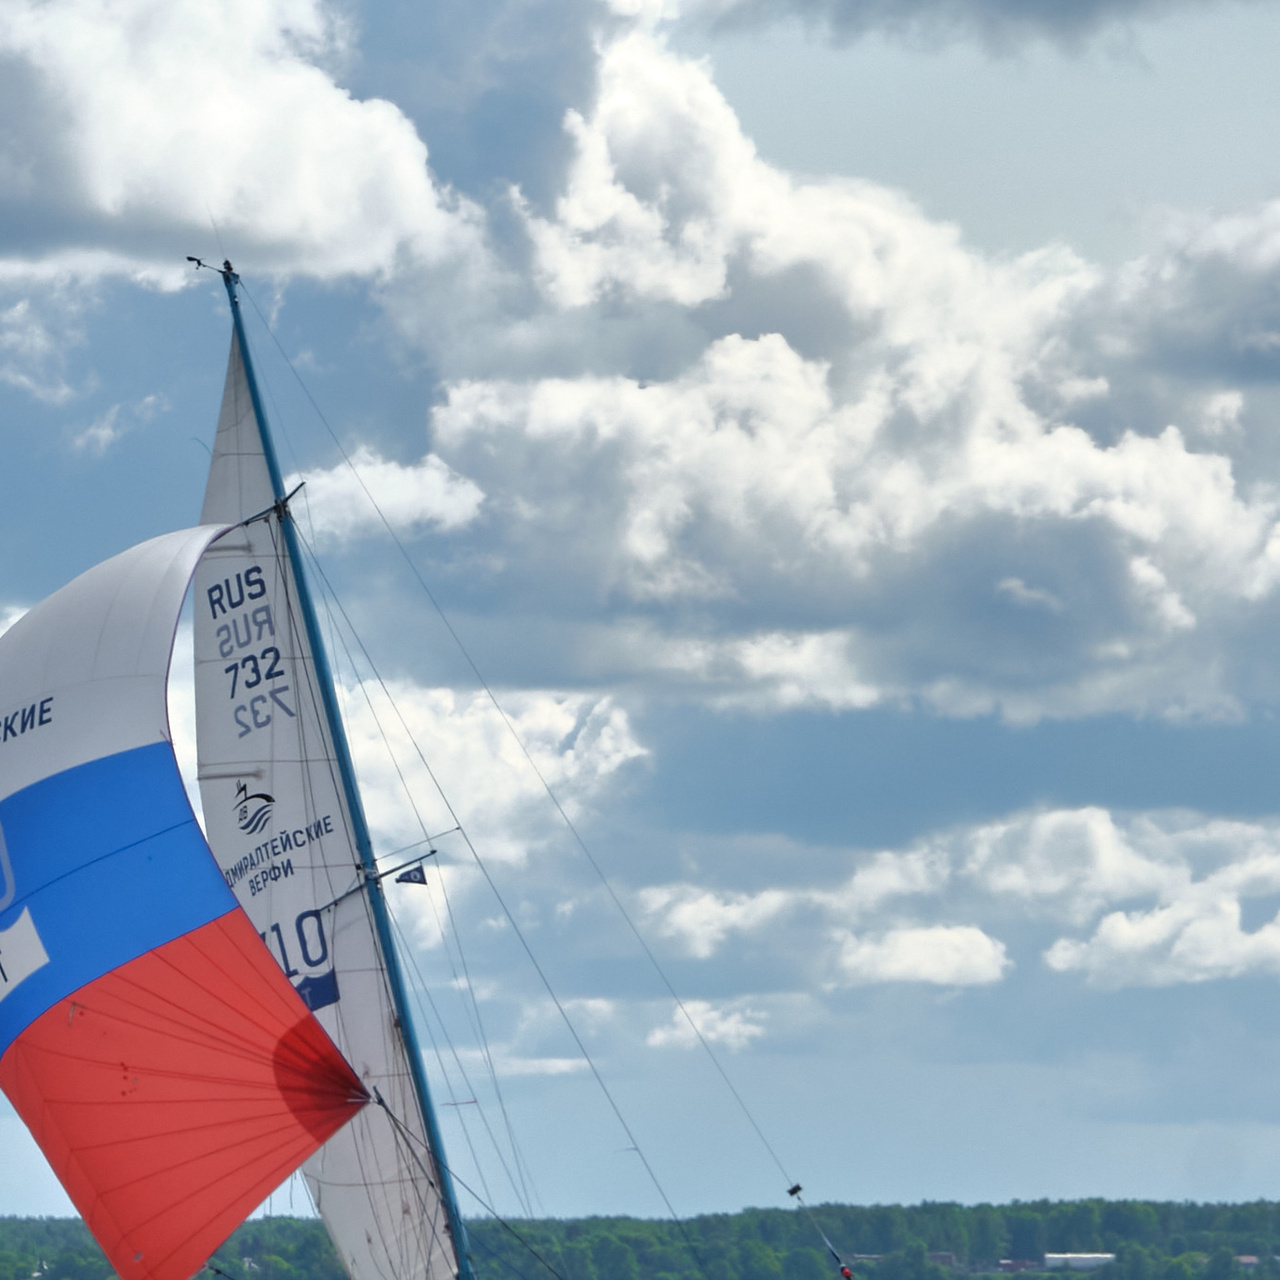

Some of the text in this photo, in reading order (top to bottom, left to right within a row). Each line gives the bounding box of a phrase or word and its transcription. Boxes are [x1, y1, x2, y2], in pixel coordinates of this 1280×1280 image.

[207, 566, 266, 619] RUS
[225, 646, 285, 699] 732
[225, 815, 334, 888] ДМИРАЛТЕЙСКИЕ
[248, 858, 294, 897] ВЕРФИ
[260, 909, 328, 978] 10
